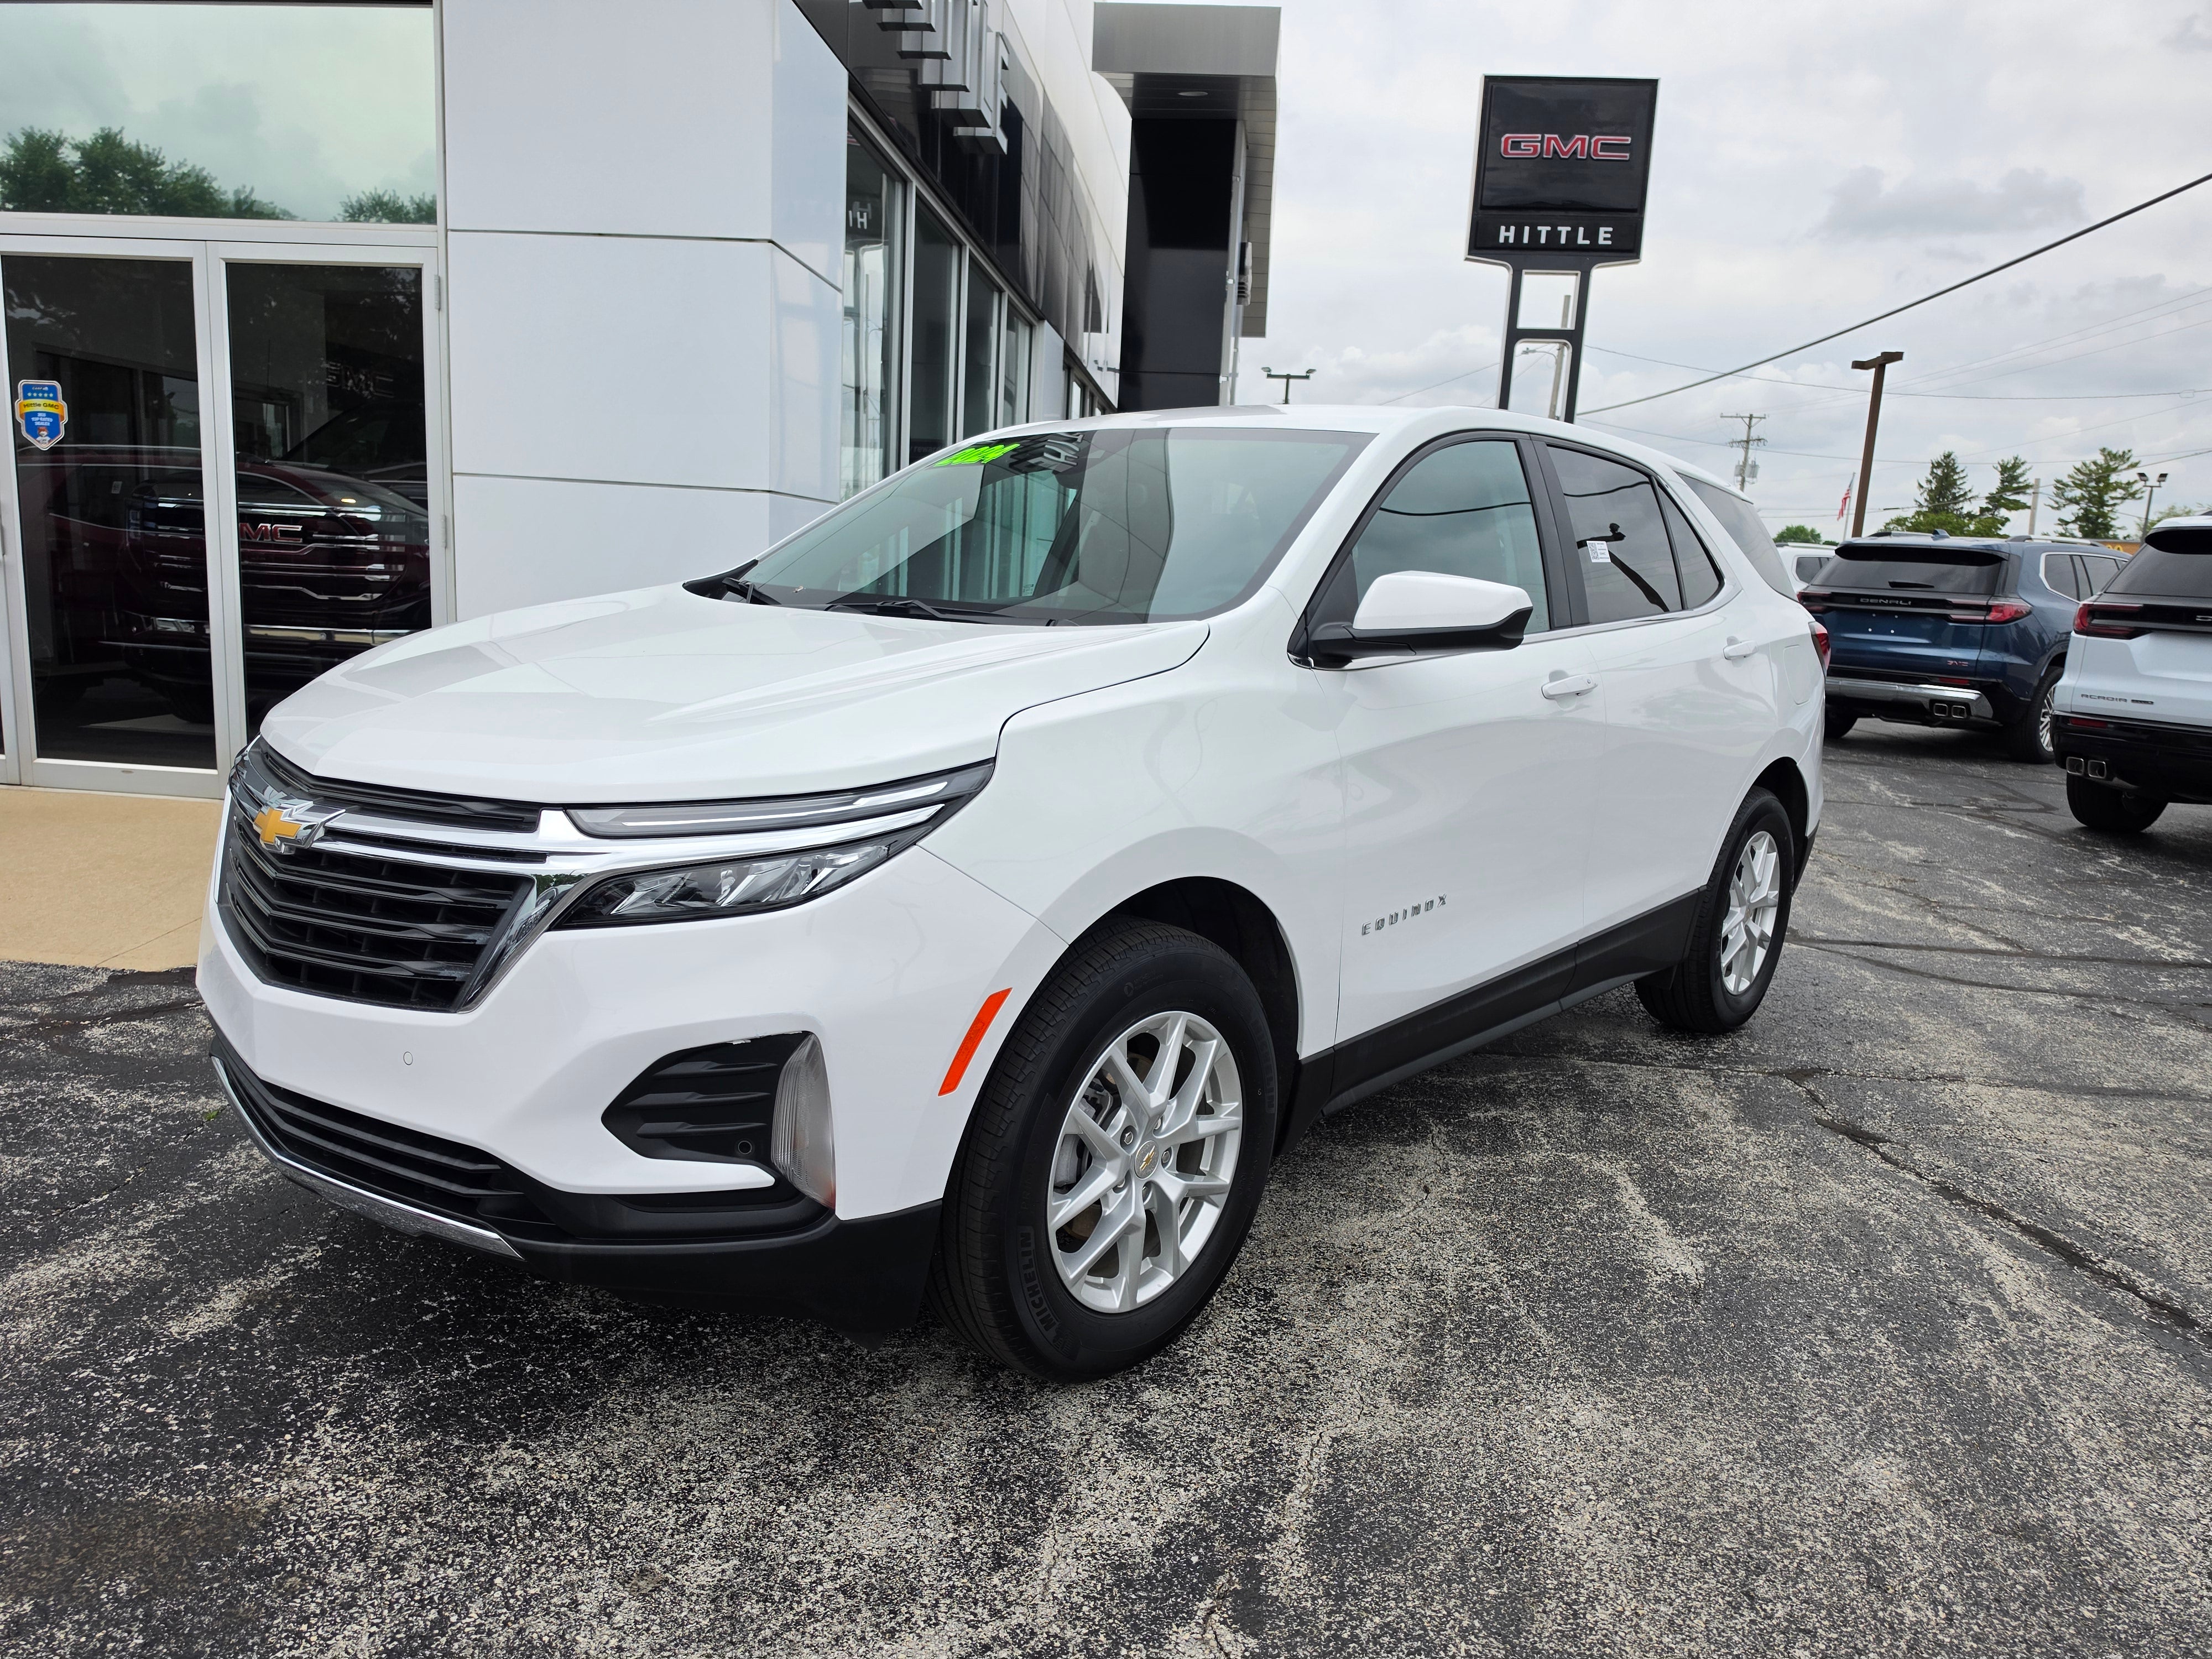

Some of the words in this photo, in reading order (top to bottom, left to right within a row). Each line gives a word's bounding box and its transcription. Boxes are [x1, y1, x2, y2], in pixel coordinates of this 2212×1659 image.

[1501, 133, 1631, 160] GMC
[1499, 225, 1613, 245] HITTLE
[239, 523, 302, 542] MC
[2081, 693, 2127, 703] ACADIA
[1361, 893, 1447, 936] EQUINOX
[1020, 1232, 1057, 1332] MICHELIN
